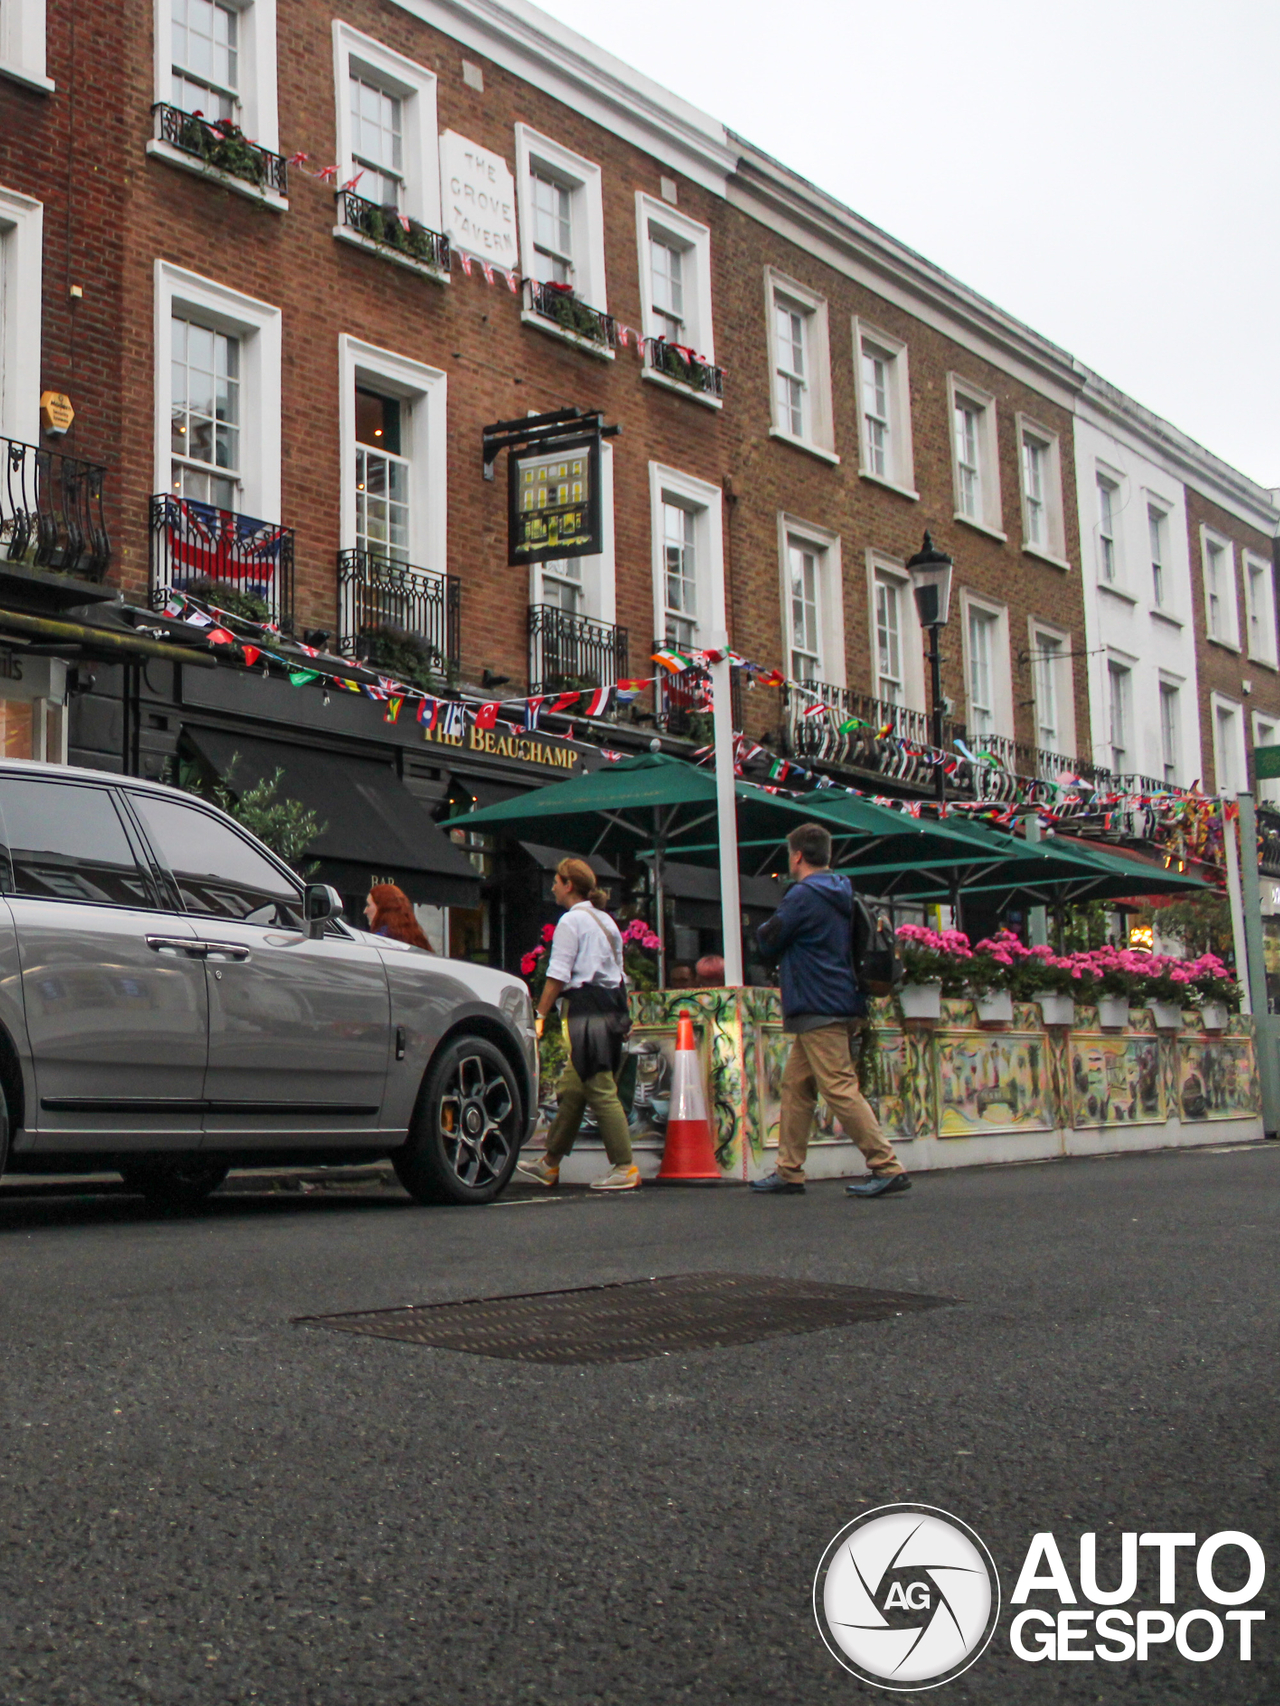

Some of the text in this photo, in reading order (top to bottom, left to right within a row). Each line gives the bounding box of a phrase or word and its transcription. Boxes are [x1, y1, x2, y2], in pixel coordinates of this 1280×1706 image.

[464, 152, 496, 184] THE
[451, 177, 512, 223] GROVE
[453, 205, 513, 251] TAVERN
[470, 724, 578, 769] BEAUCHAMP
